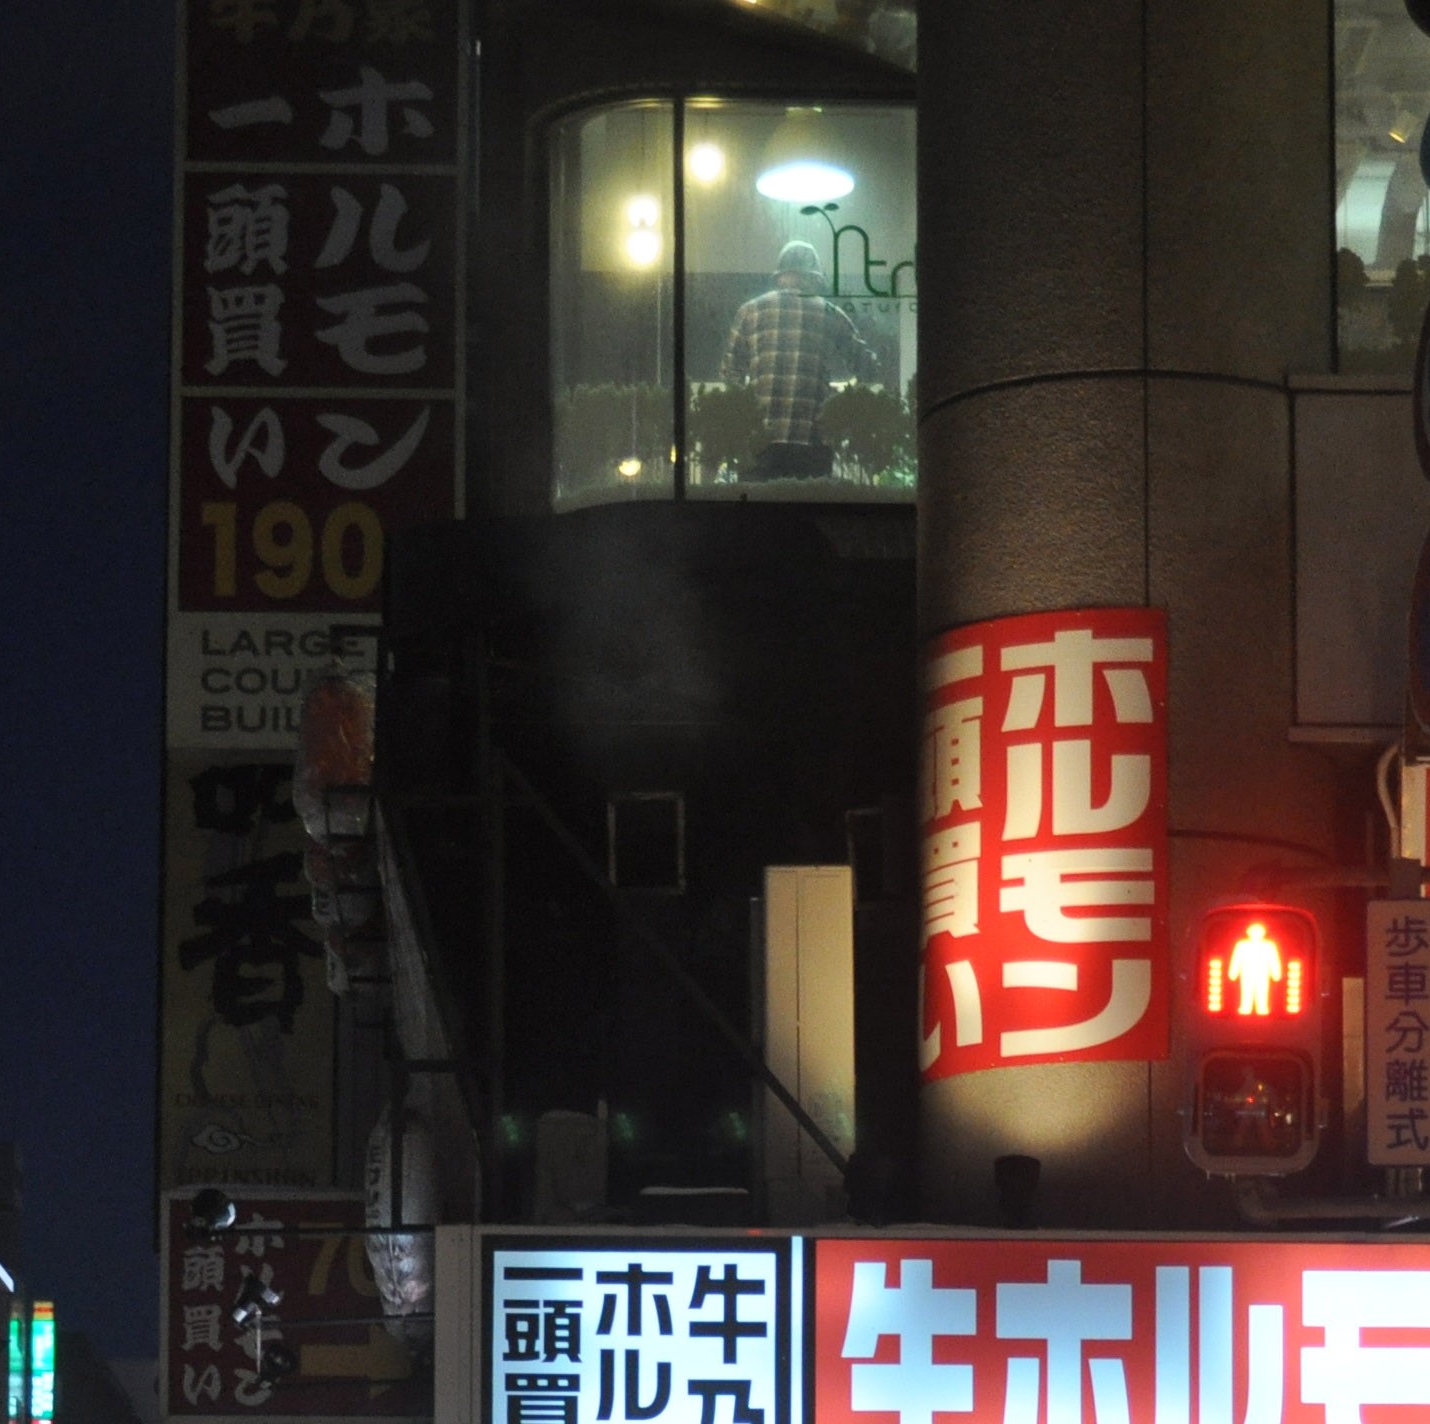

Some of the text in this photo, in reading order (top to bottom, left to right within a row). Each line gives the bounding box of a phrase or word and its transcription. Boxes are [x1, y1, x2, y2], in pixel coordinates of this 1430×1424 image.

[205, 95, 294, 490] 一頭買い
[315, 66, 435, 490] ホルモン
[202, 502, 384, 599] 190
[1000, 629, 1154, 1057] ホルモン
[1385, 917, 1430, 1151] 歩車分離式
